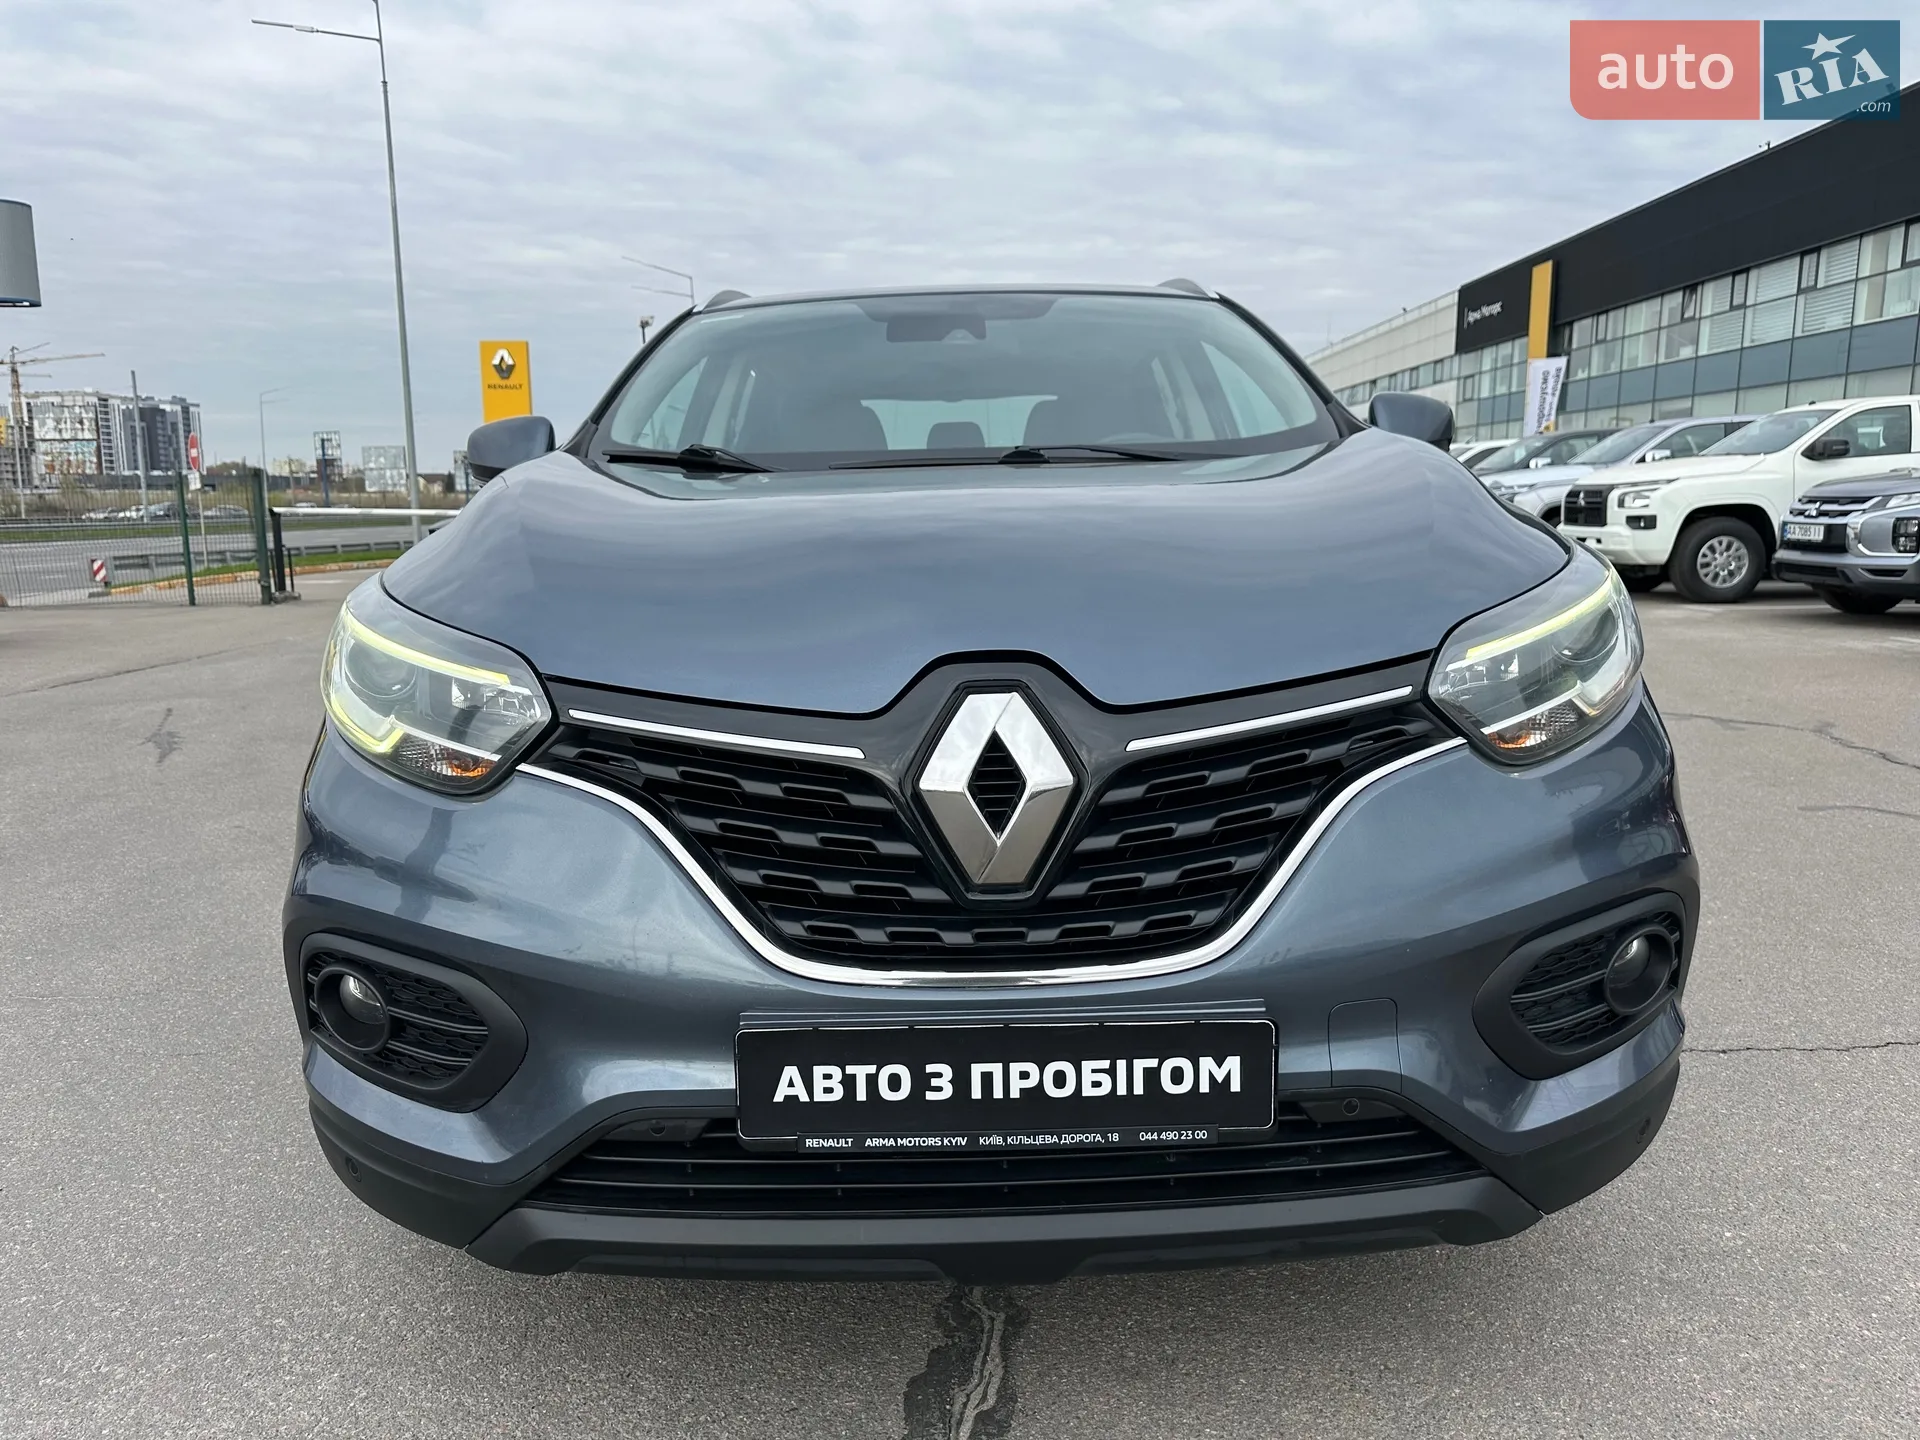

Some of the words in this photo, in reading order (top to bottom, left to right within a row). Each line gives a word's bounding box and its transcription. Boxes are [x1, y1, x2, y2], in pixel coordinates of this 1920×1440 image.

[772, 1063, 912, 1103] АВТО
[970, 1055, 1242, 1100] ПРОБІГОМ
[805, 1138, 854, 1148] RENAULT
[864, 1137, 895, 1147] ARMA
[897, 1137, 942, 1147] MOTORS
[943, 1136, 968, 1146] KYIV
[979, 1134, 1006, 1147] КИЇВ,
[1007, 1134, 1059, 1146] КІЛЬЦЕВА
[1060, 1133, 1105, 1145] ДОРОГА,
[1107, 1132, 1120, 1142] 18
[1139, 1131, 1158, 1141] 044
[1160, 1130, 1179, 1141] 490
[1180, 1130, 1193, 1140] 23
[1194, 1130, 1208, 1140] 00
